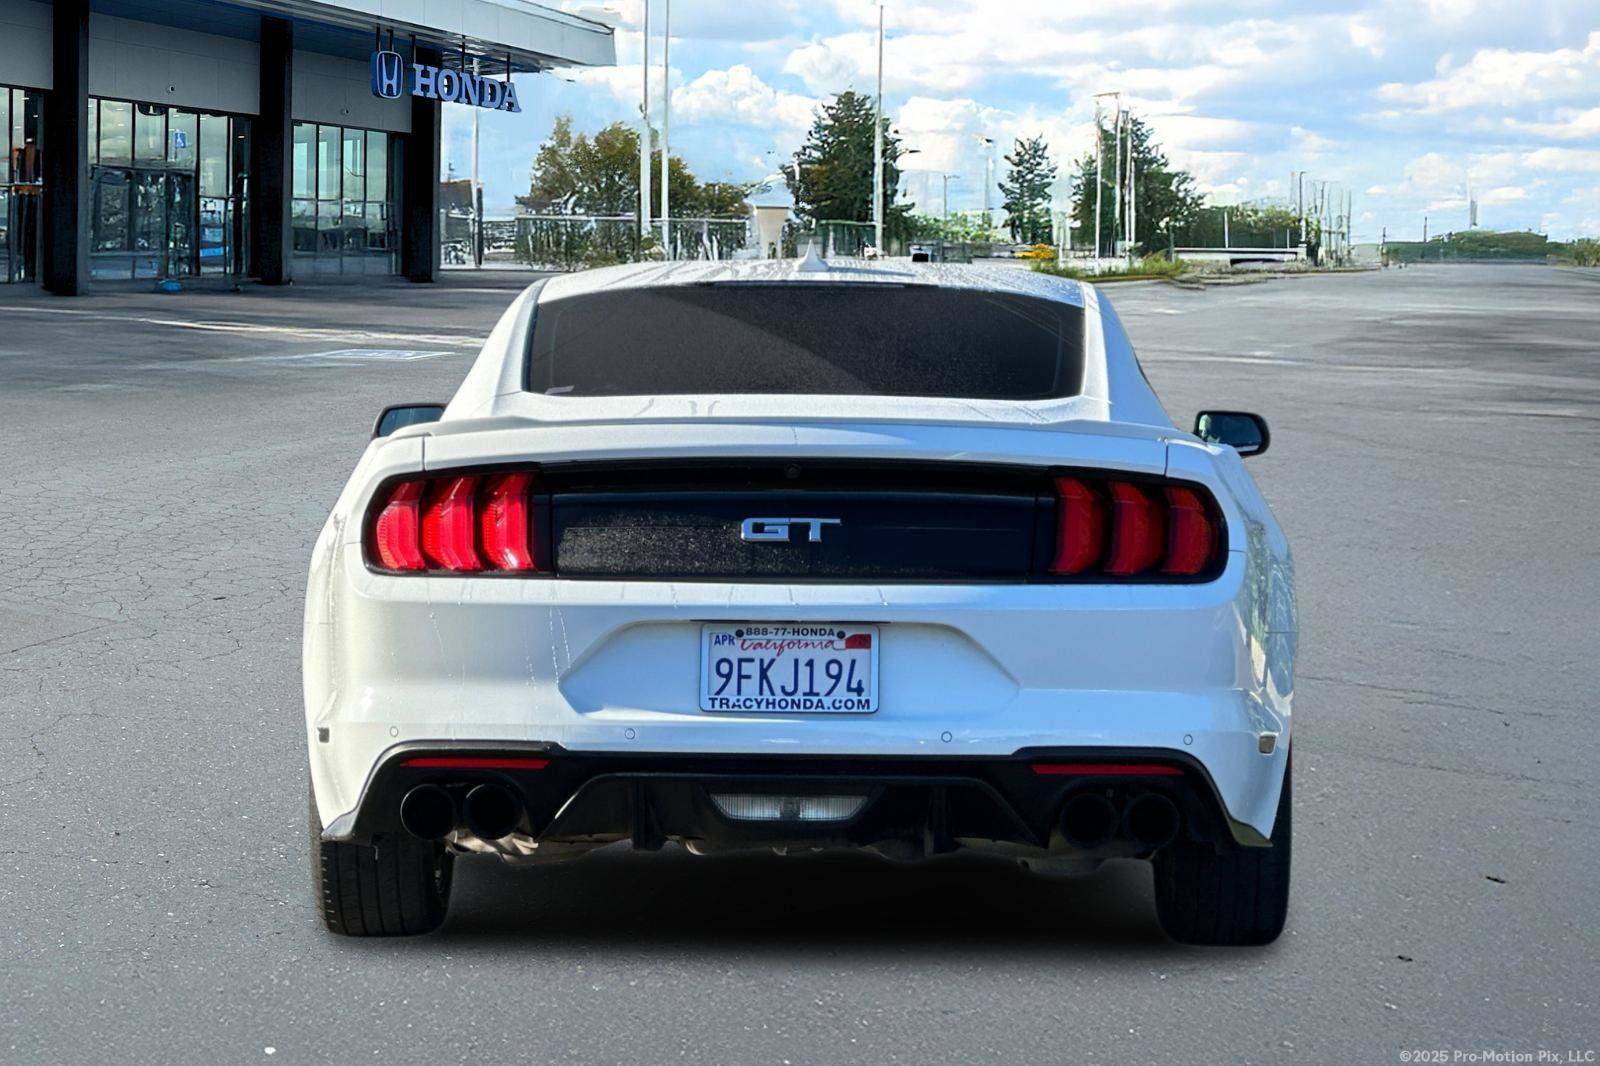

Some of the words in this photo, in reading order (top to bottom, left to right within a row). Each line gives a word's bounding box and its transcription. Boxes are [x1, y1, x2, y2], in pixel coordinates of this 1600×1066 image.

[411, 63, 521, 112] HONDA
[741, 517, 841, 542] GT
[714, 634, 735, 646] APR
[745, 627, 835, 637] 888-77-HONDA
[740, 638, 836, 657] California
[714, 657, 865, 697] 9FKJ194
[709, 697, 871, 710] TRACYHONDA.COM
